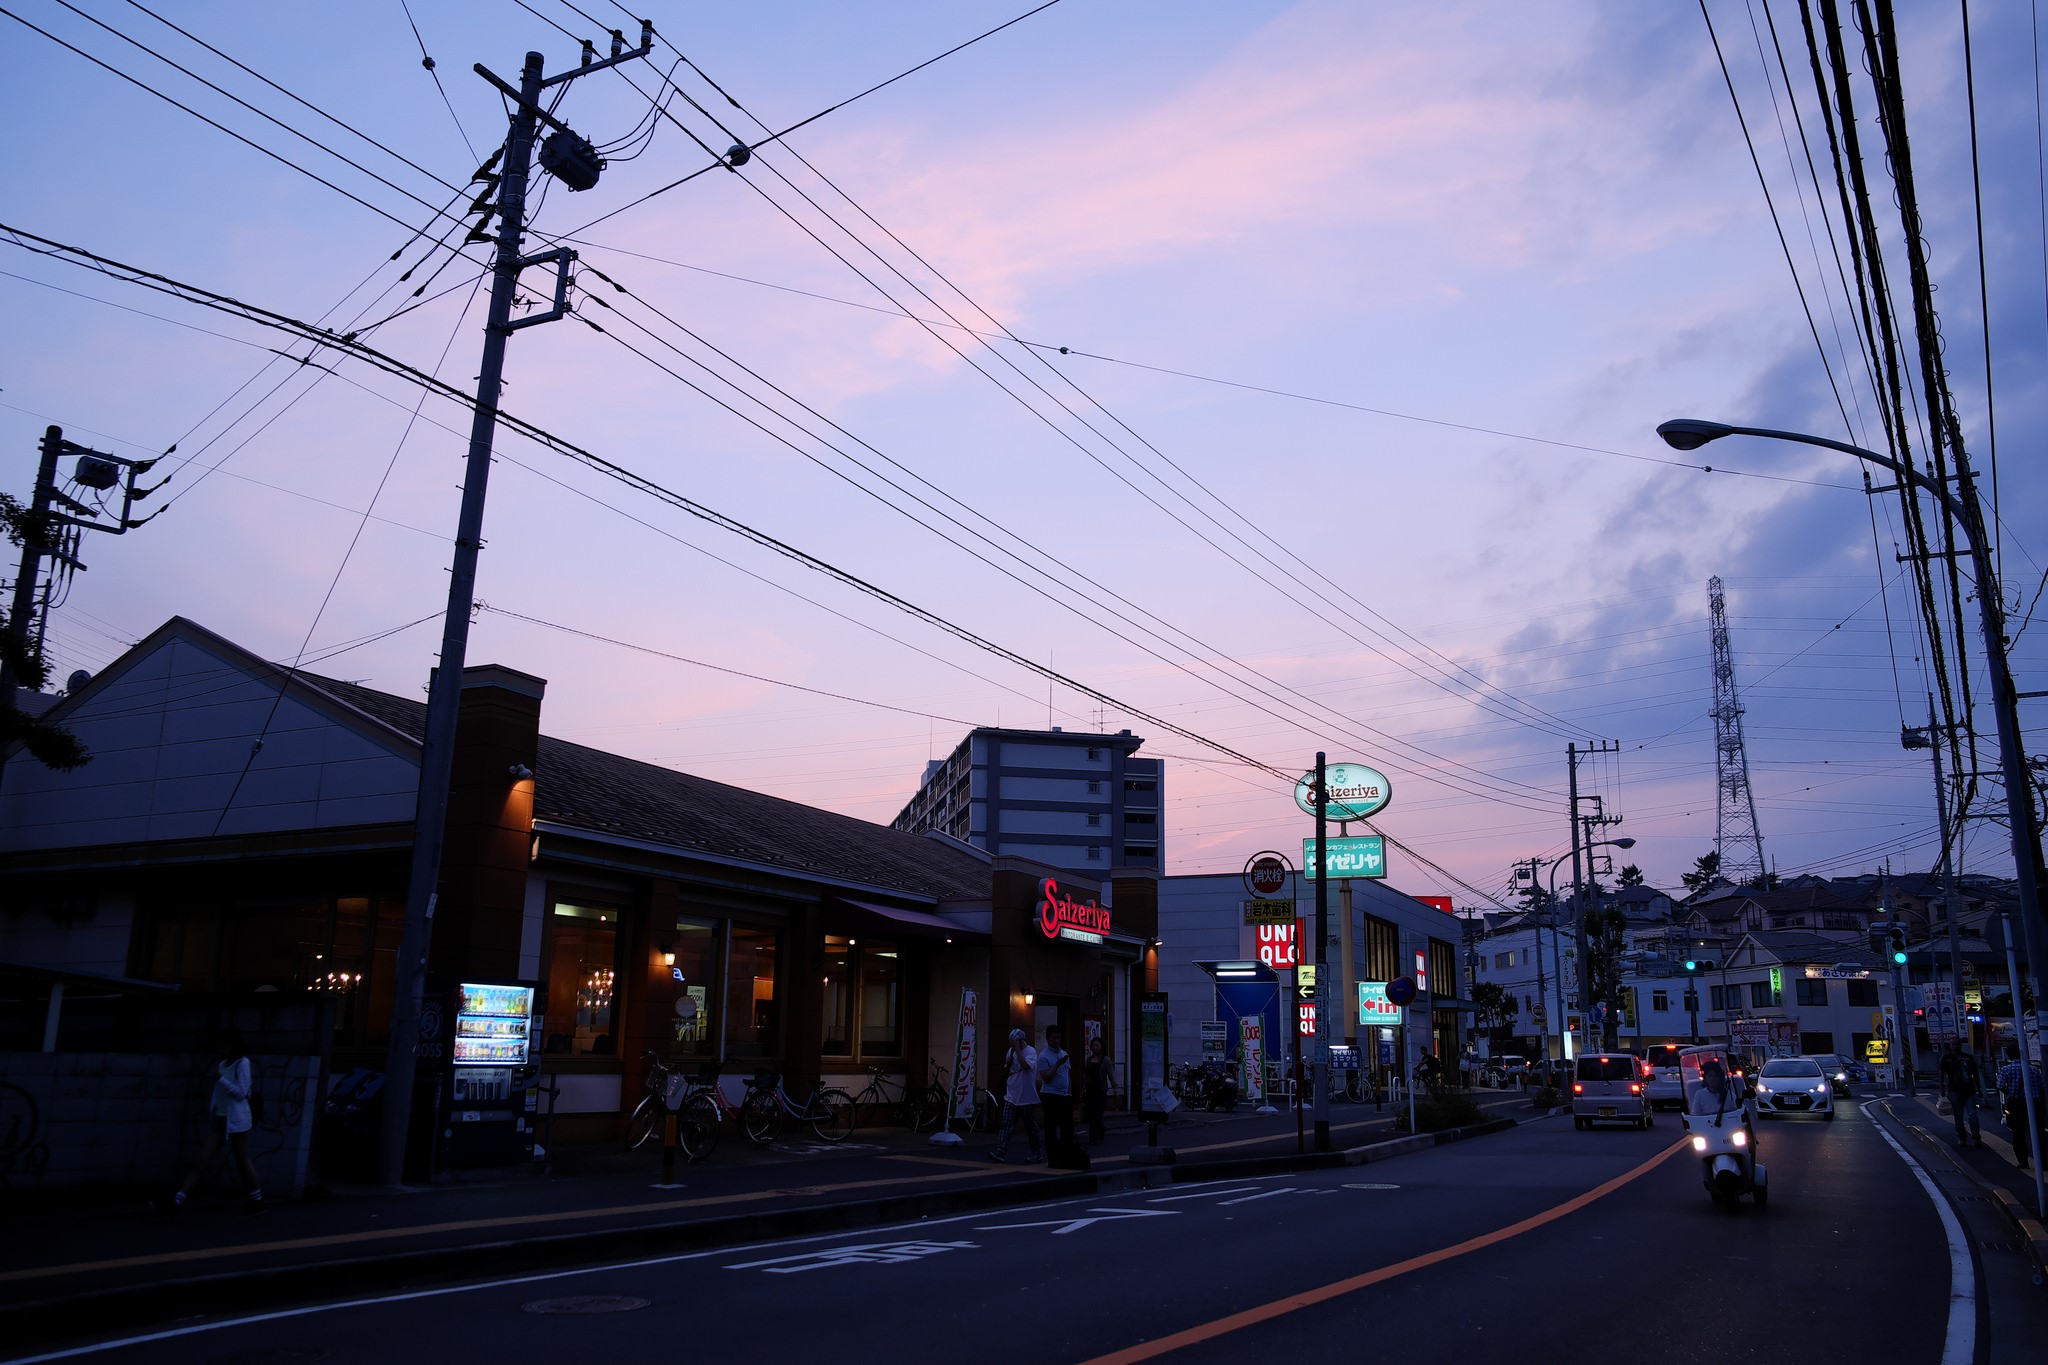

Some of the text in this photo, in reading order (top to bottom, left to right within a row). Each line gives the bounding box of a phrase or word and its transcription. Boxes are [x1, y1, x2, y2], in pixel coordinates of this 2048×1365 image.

[1254, 868, 1283, 883] 消火栓
[1042, 877, 1111, 933] Saizeriya
[1253, 901, 1291, 917] 岩本歯科
[1361, 986, 1386, 995] サイゼ
[1377, 996, 1398, 1014] in
[1299, 1007, 1316, 1019] UN
[1300, 1020, 1316, 1034] QL
[956, 1041, 971, 1105] ランチ
